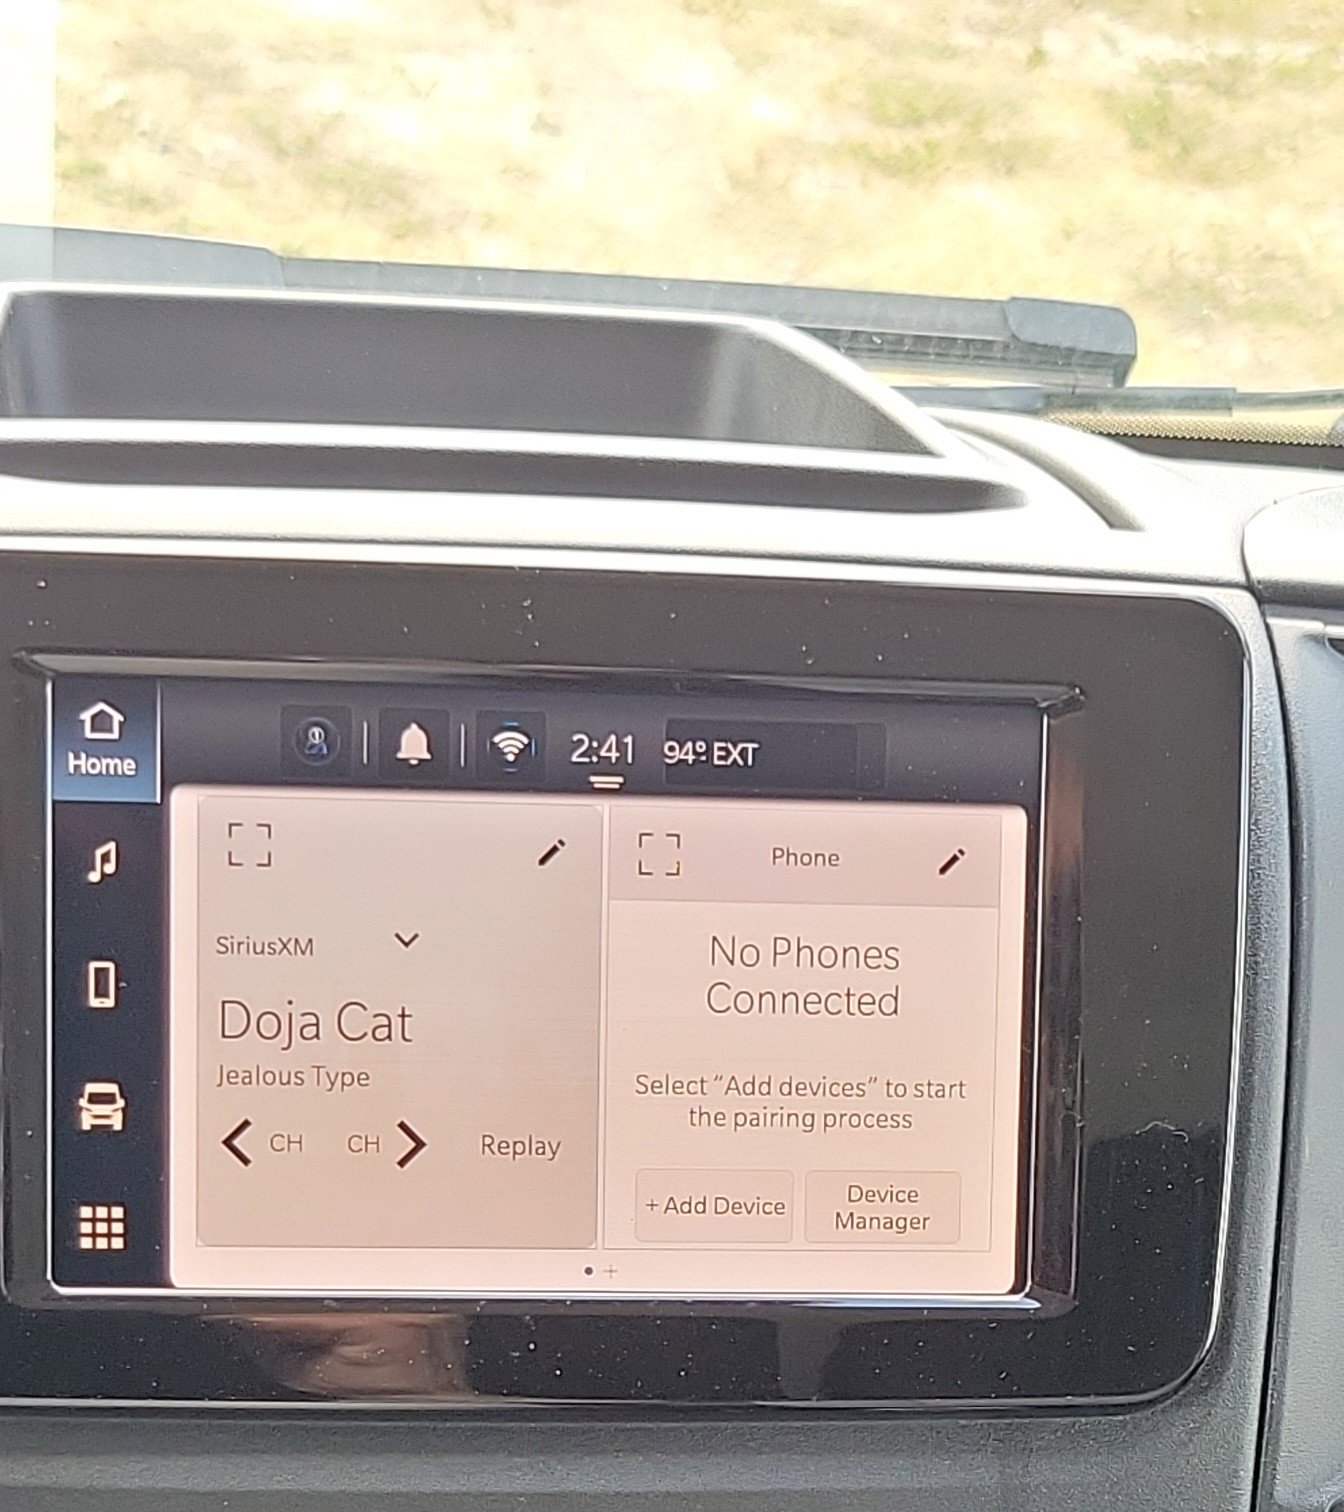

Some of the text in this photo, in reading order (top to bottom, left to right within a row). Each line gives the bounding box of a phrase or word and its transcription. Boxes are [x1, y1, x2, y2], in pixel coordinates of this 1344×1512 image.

[570, 733, 637, 767] 2:41
[712, 742, 760, 767] EXT
[67, 752, 137, 778] Home
[771, 846, 841, 869] Phone
[215, 935, 315, 958] SiriusXM
[709, 935, 901, 972] No Phones
[705, 980, 901, 1019] Connected
[218, 999, 414, 1051] Doja Cat
[216, 1064, 371, 1093] Jealous Type
[634, 1073, 709, 1098] Select
[884, 1078, 909, 1100] to
[912, 1077, 968, 1101] start
[688, 1106, 914, 1134] the pairing process
[268, 1133, 305, 1154] CH
[346, 1134, 382, 1155] CH
[479, 1133, 562, 1163] Replay
[663, 1194, 708, 1217] Add
[713, 1195, 787, 1218] Device
[846, 1184, 920, 1205] Device
[834, 1211, 932, 1236] Manager
